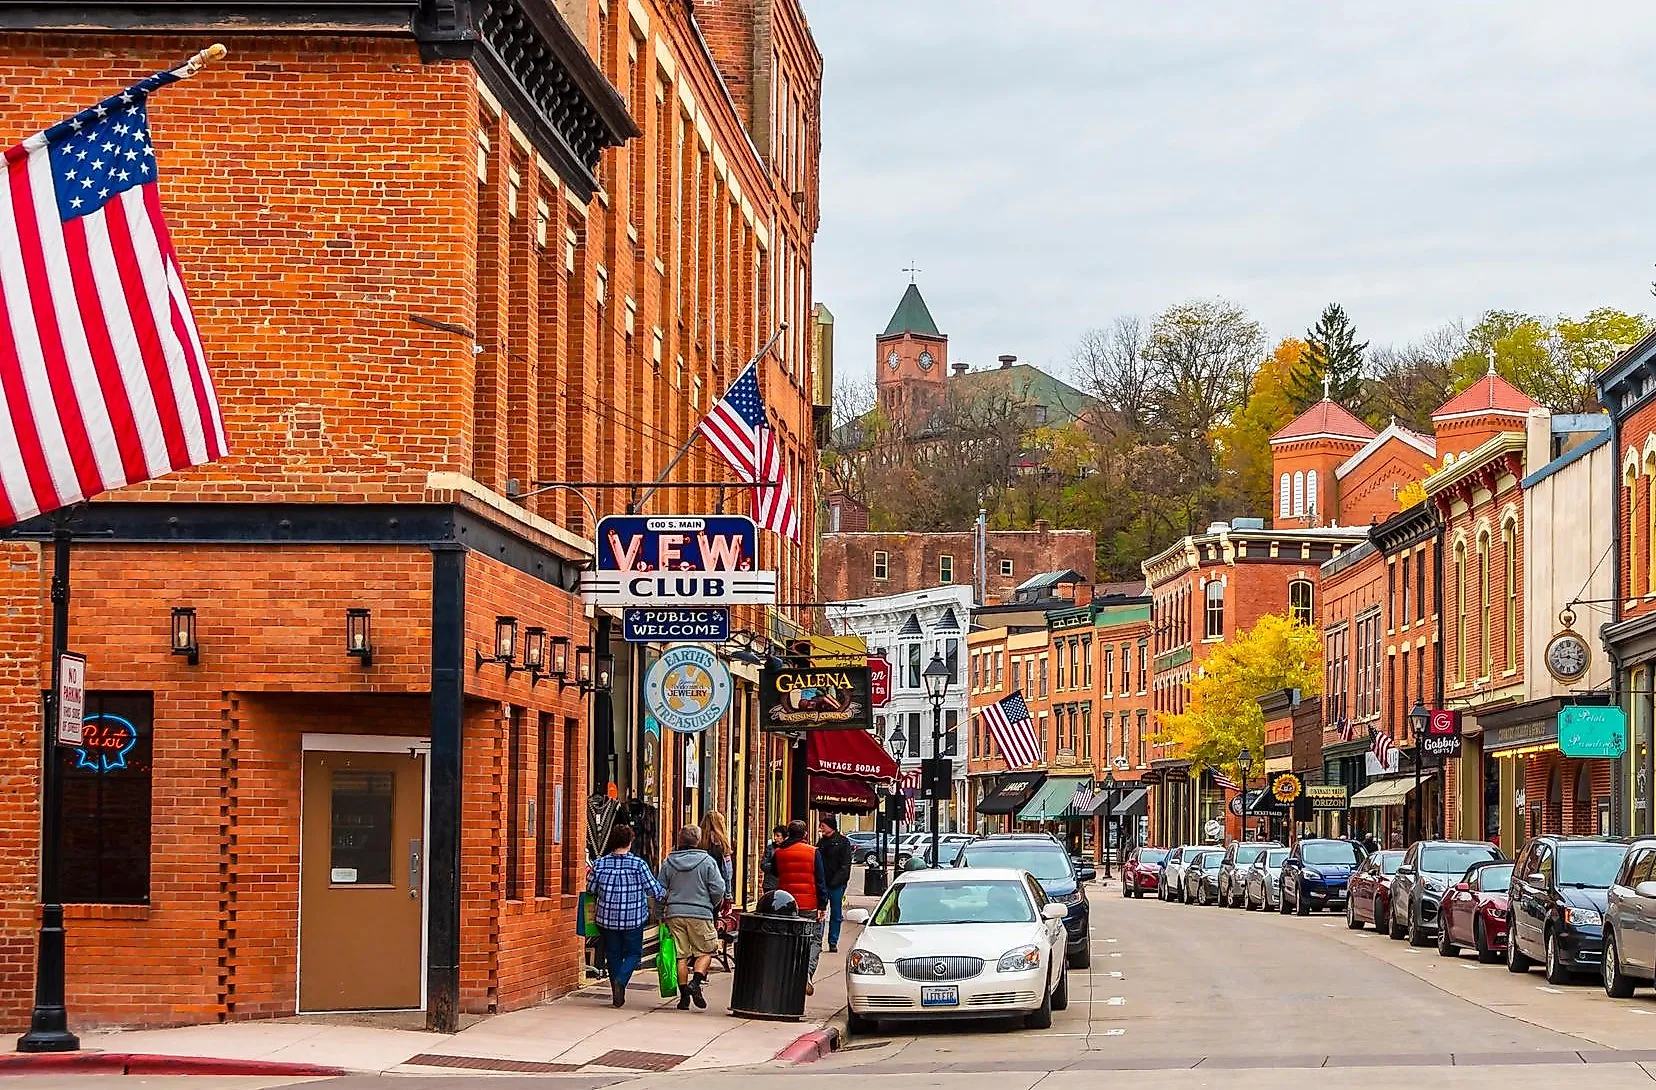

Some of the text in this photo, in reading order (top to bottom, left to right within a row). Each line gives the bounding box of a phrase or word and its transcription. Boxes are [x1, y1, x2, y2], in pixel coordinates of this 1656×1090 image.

[650, 521, 702, 529] 100 S. MAIN
[628, 577, 726, 597] CLUB
[644, 611, 709, 623] PUBLIC
[632, 624, 721, 636] WELCOME
[664, 650, 714, 668] EARTH'S
[68, 667, 77, 685] NO
[775, 672, 855, 693] GALENA
[63, 685, 82, 703] PARKING
[667, 689, 708, 697] JEWELRY
[63, 706, 81, 720] THIS SIDE
[655, 702, 721, 729] TREASURES
[1424, 736, 1461, 755] Gabby's
[819, 759, 881, 774] VINTAGE SODAS
